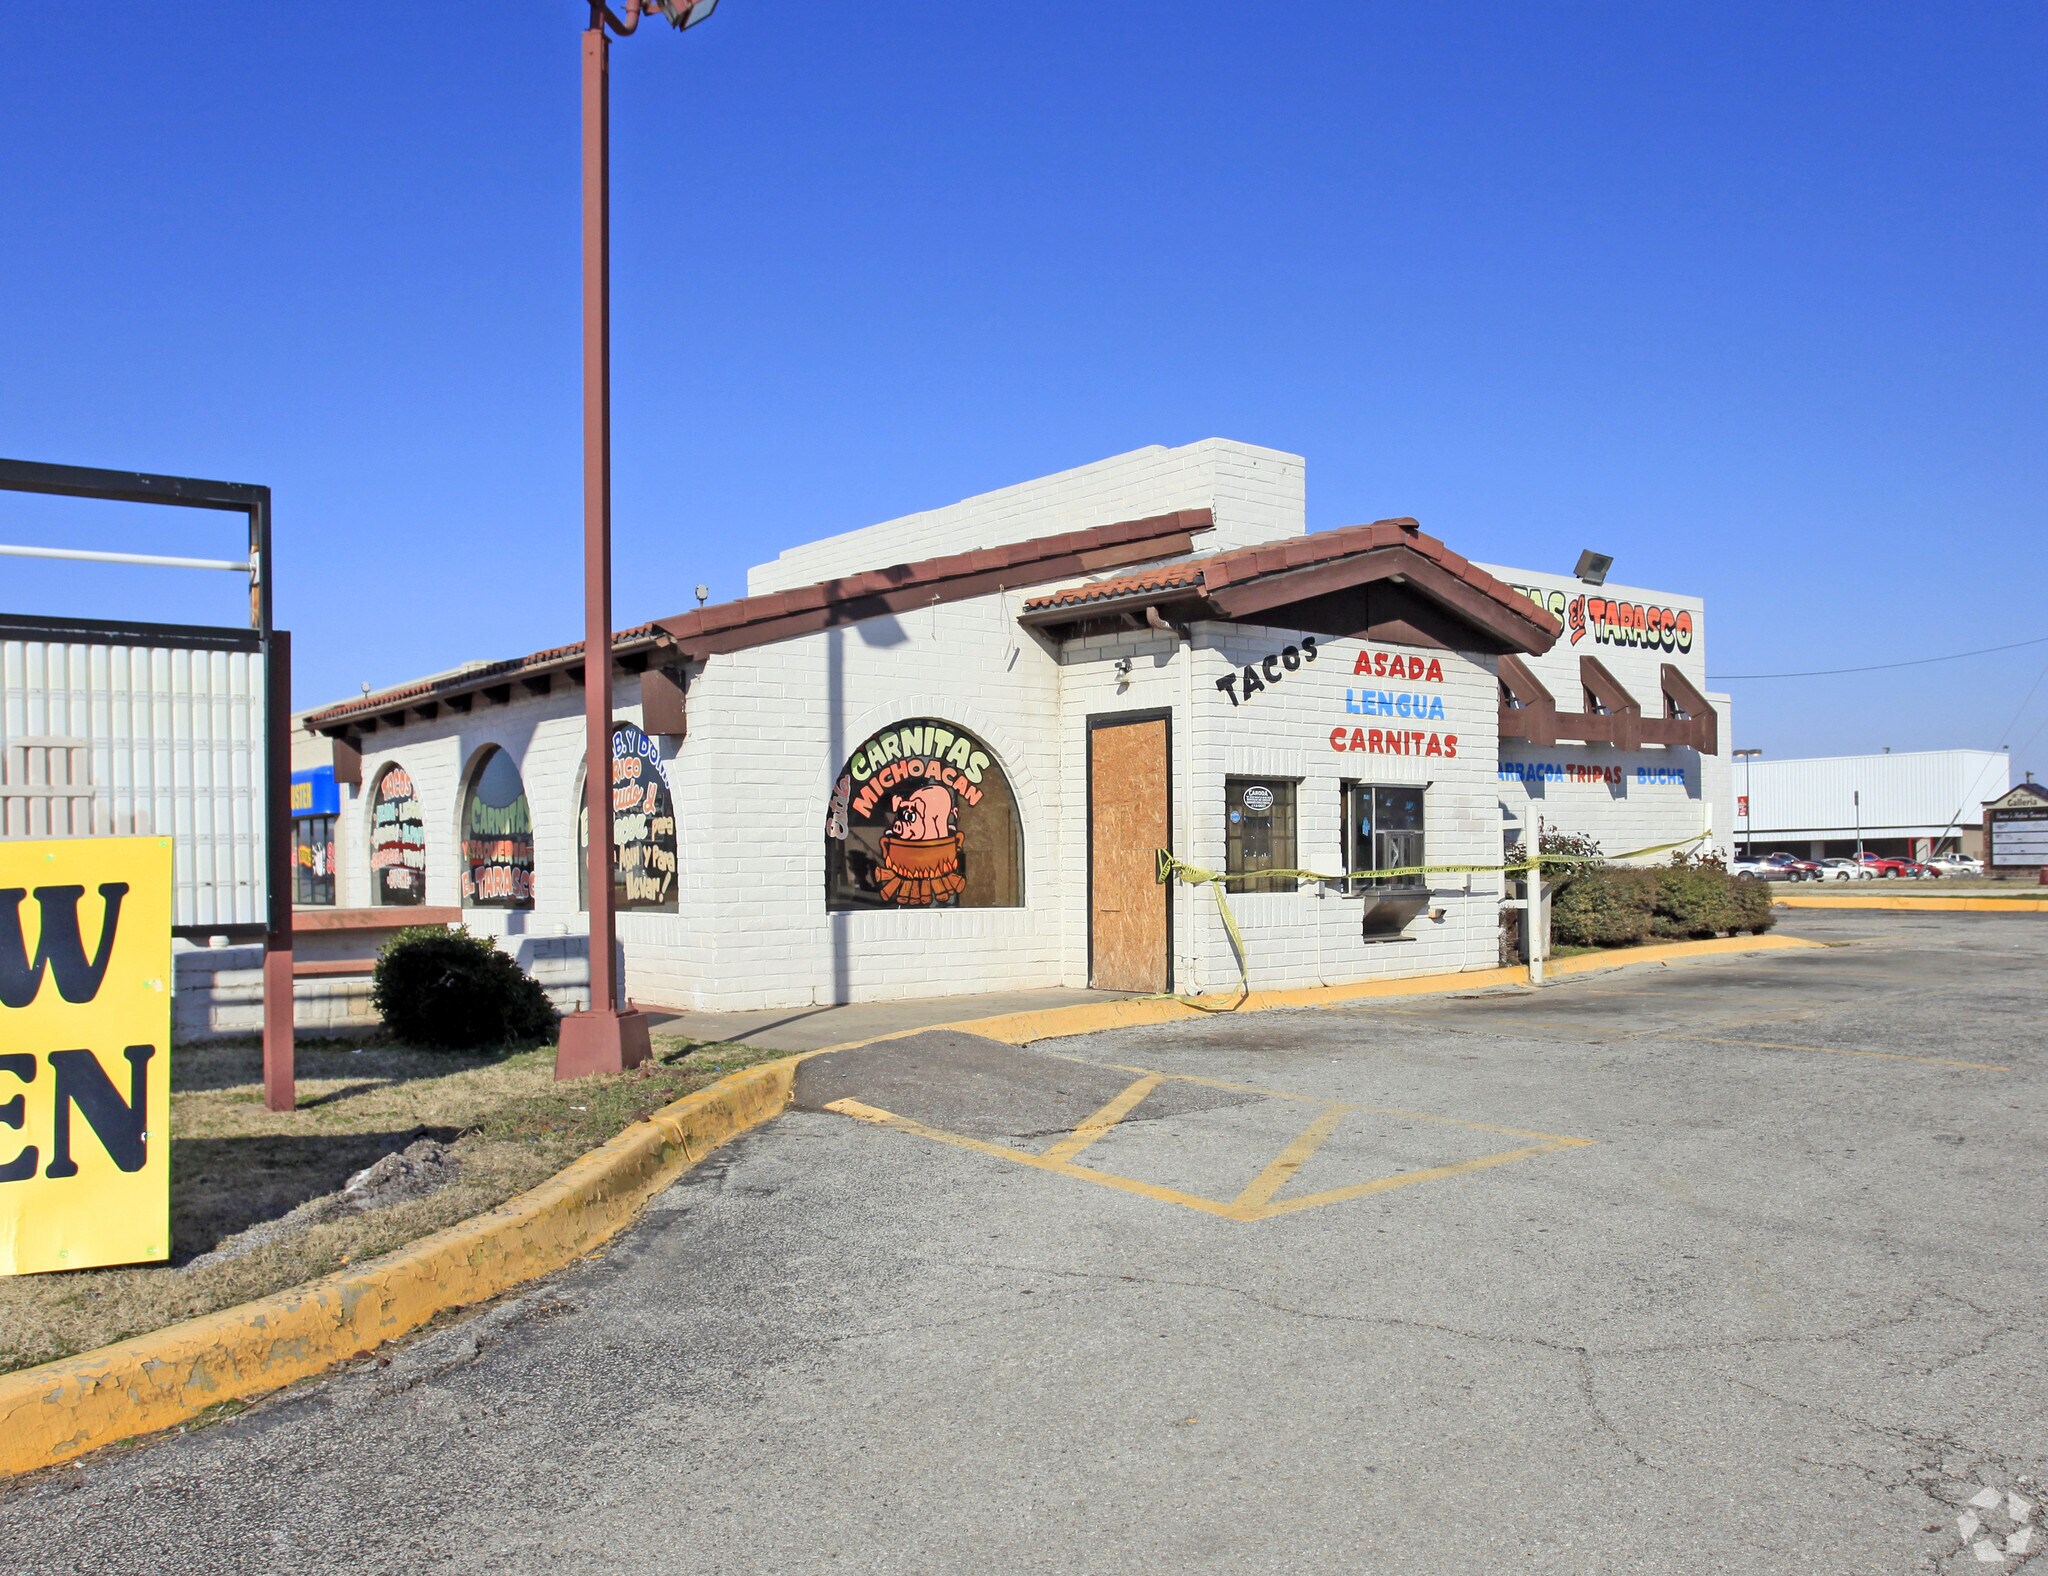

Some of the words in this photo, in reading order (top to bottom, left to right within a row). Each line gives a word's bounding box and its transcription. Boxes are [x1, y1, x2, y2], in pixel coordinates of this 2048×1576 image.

[1588, 597, 1692, 654] TARASCO
[1215, 636, 1319, 707] TACOS
[1353, 650, 1444, 682] ASADA
[1346, 688, 1445, 720] LENGUA
[851, 726, 991, 784] CARNITAS
[1329, 727, 1459, 758] CARNITAS
[852, 758, 984, 818] MICHOACAN
[1498, 761, 1564, 783] ARBACOA
[1566, 763, 1622, 784] TRIPAS
[1637, 767, 1685, 785] BUCHE
[469, 840, 528, 866] TAQUERIA
[0, 882, 130, 1009] W
[0, 1044, 156, 1183] EN
